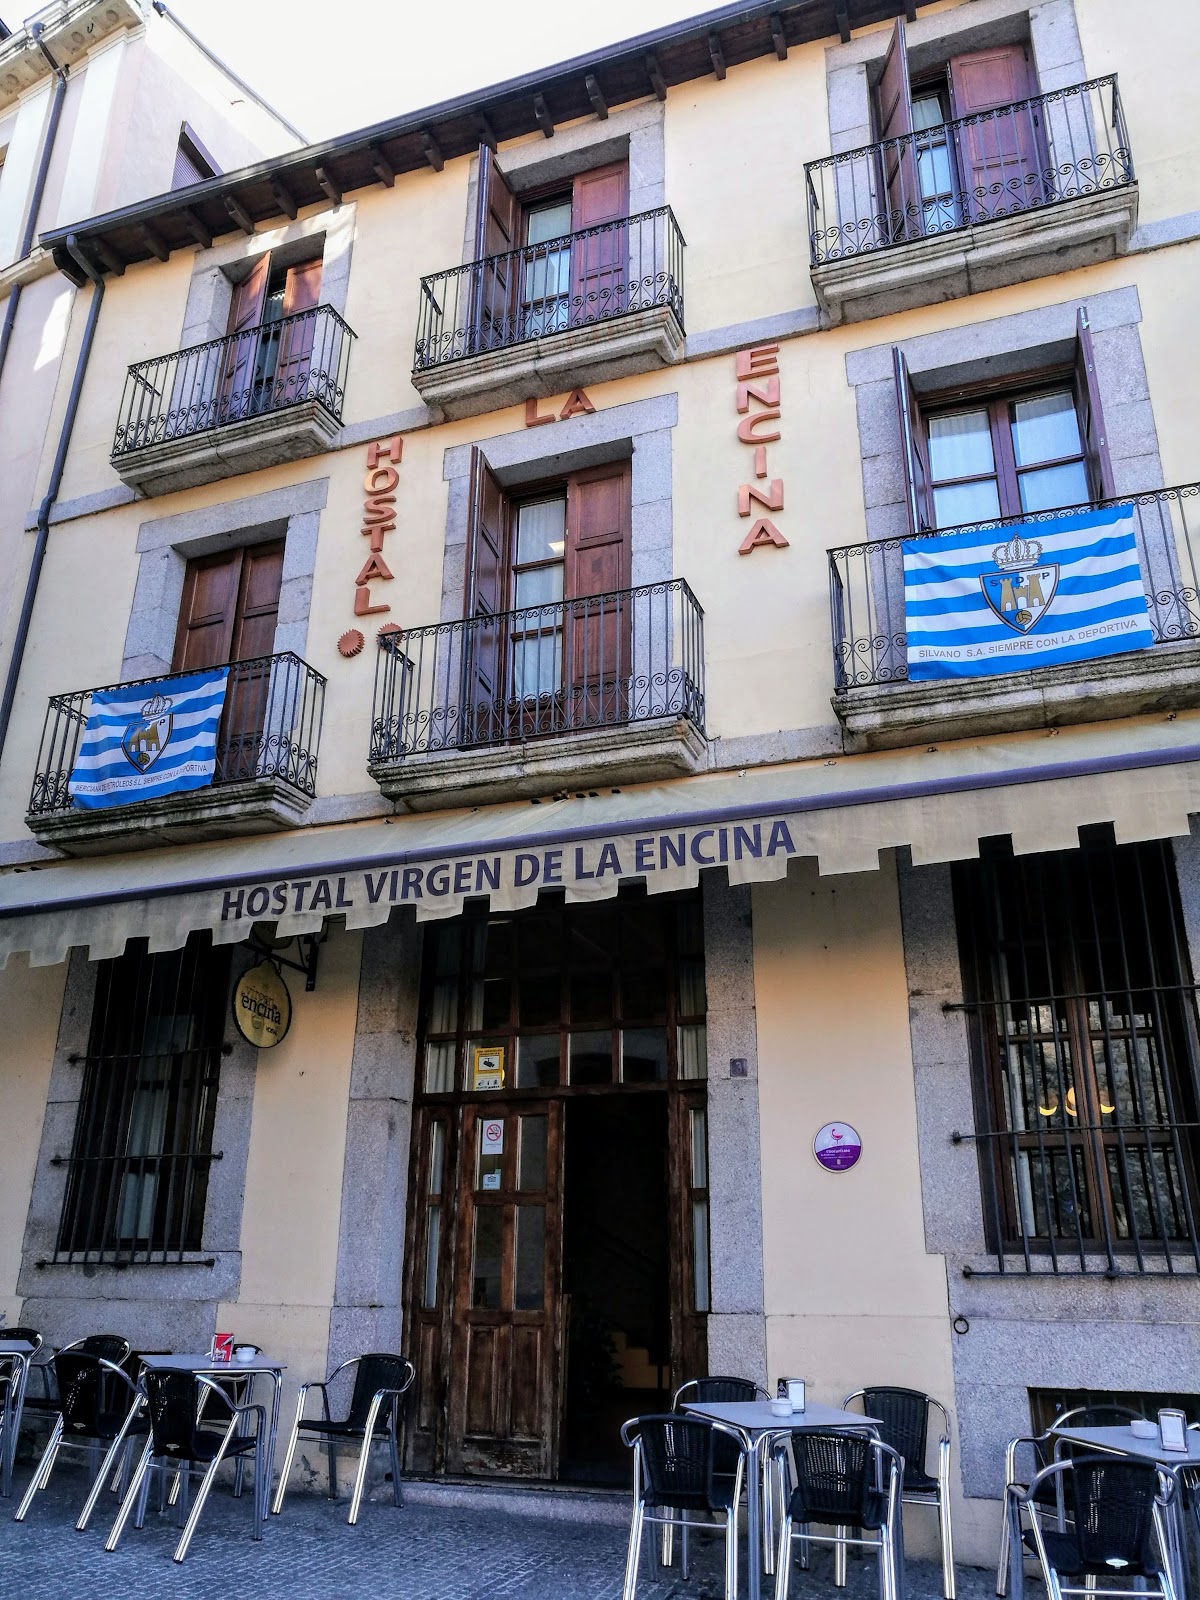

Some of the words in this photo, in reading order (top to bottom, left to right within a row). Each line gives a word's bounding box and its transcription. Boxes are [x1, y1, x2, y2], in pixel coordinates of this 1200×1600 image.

[525, 388, 597, 428] LA
[736, 344, 790, 555] ENCINA
[353, 436, 404, 616] HOSTAL
[919, 648, 961, 659] SILVANO
[966, 647, 986, 657] S.A.
[988, 640, 1034, 655] SIEMPRE
[1036, 638, 1058, 649] CON
[1061, 634, 1076, 644] LA
[1078, 619, 1139, 641] DEPORTIVA
[143, 774, 163, 785] SIEMPRE
[163, 771, 174, 780] CON
[220, 876, 356, 922] HOSTAL
[363, 856, 502, 902] VIRGEN
[513, 849, 564, 888] DE
[575, 842, 623, 881] LA
[635, 820, 797, 872] ENCINA
